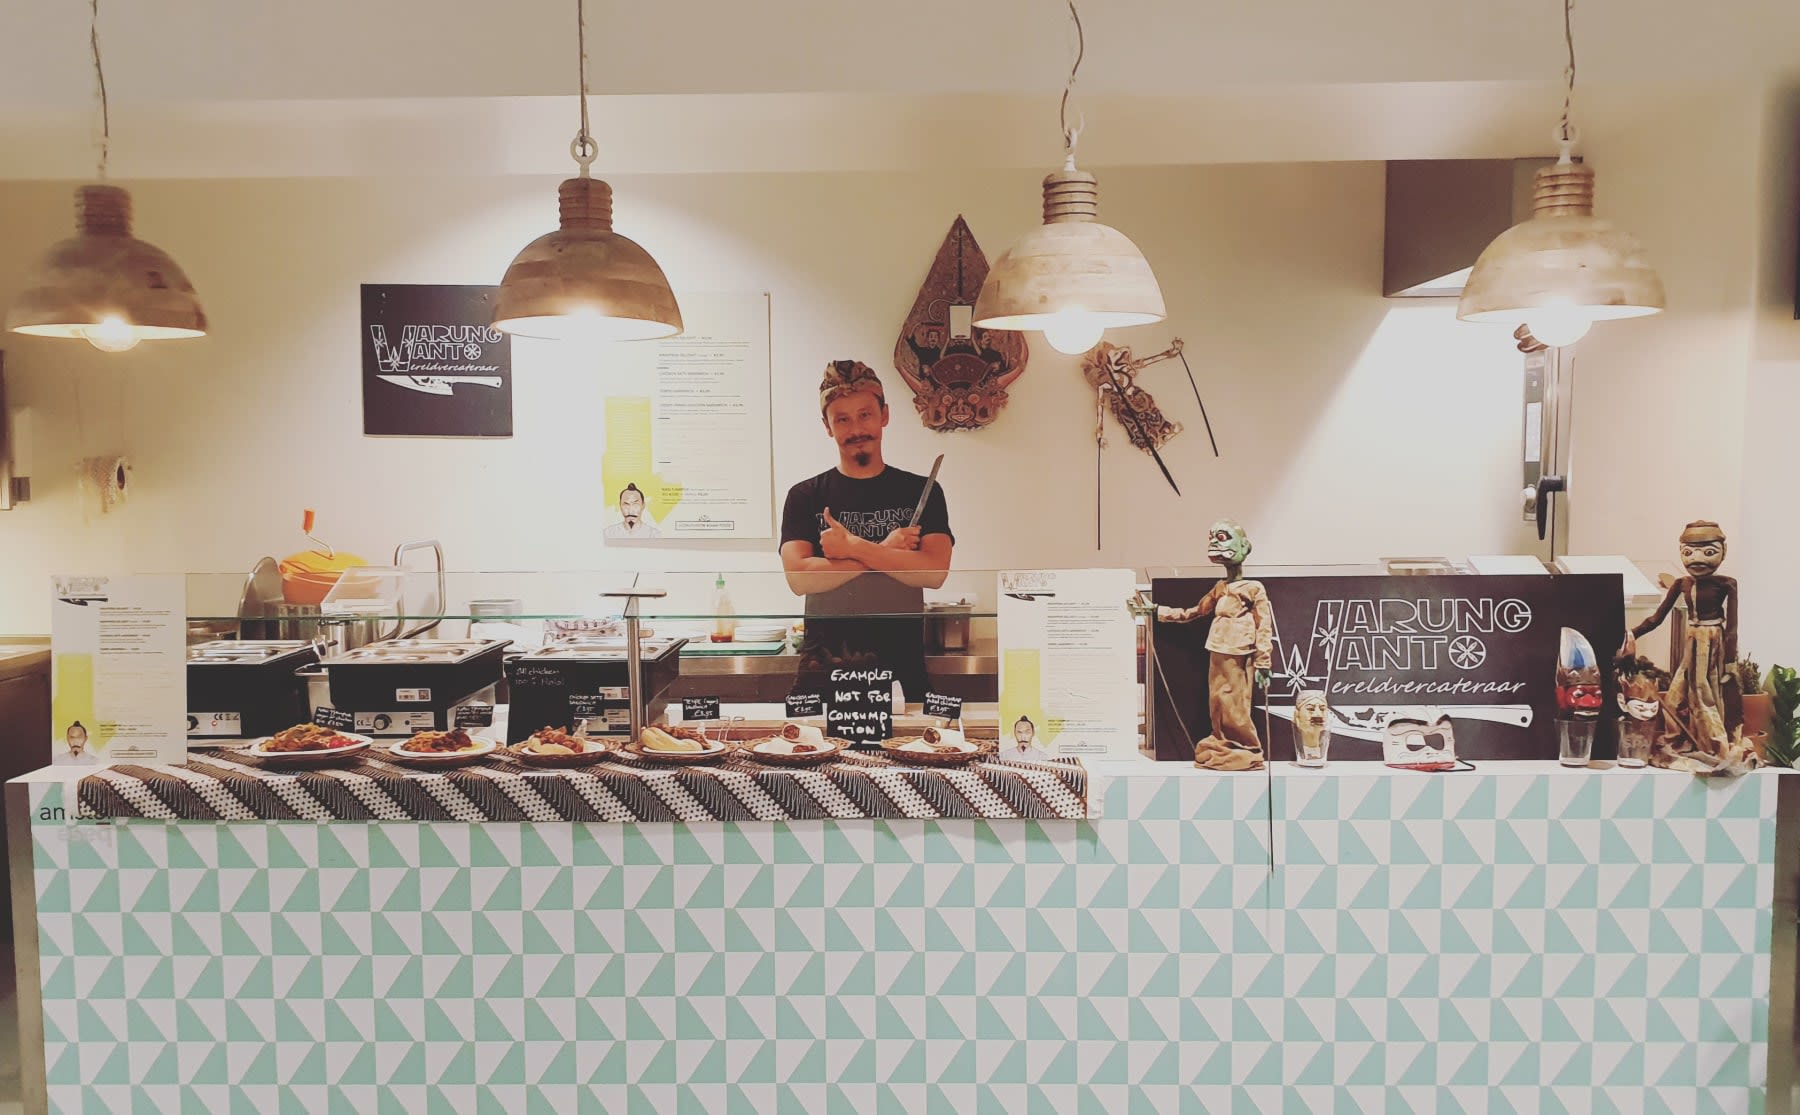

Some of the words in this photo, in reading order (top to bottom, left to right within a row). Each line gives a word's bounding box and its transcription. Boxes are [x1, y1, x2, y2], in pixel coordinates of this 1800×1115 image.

[830, 668, 893, 686] EXAMPLES
[835, 690, 861, 703] NOT
[867, 690, 891, 703] FOR
